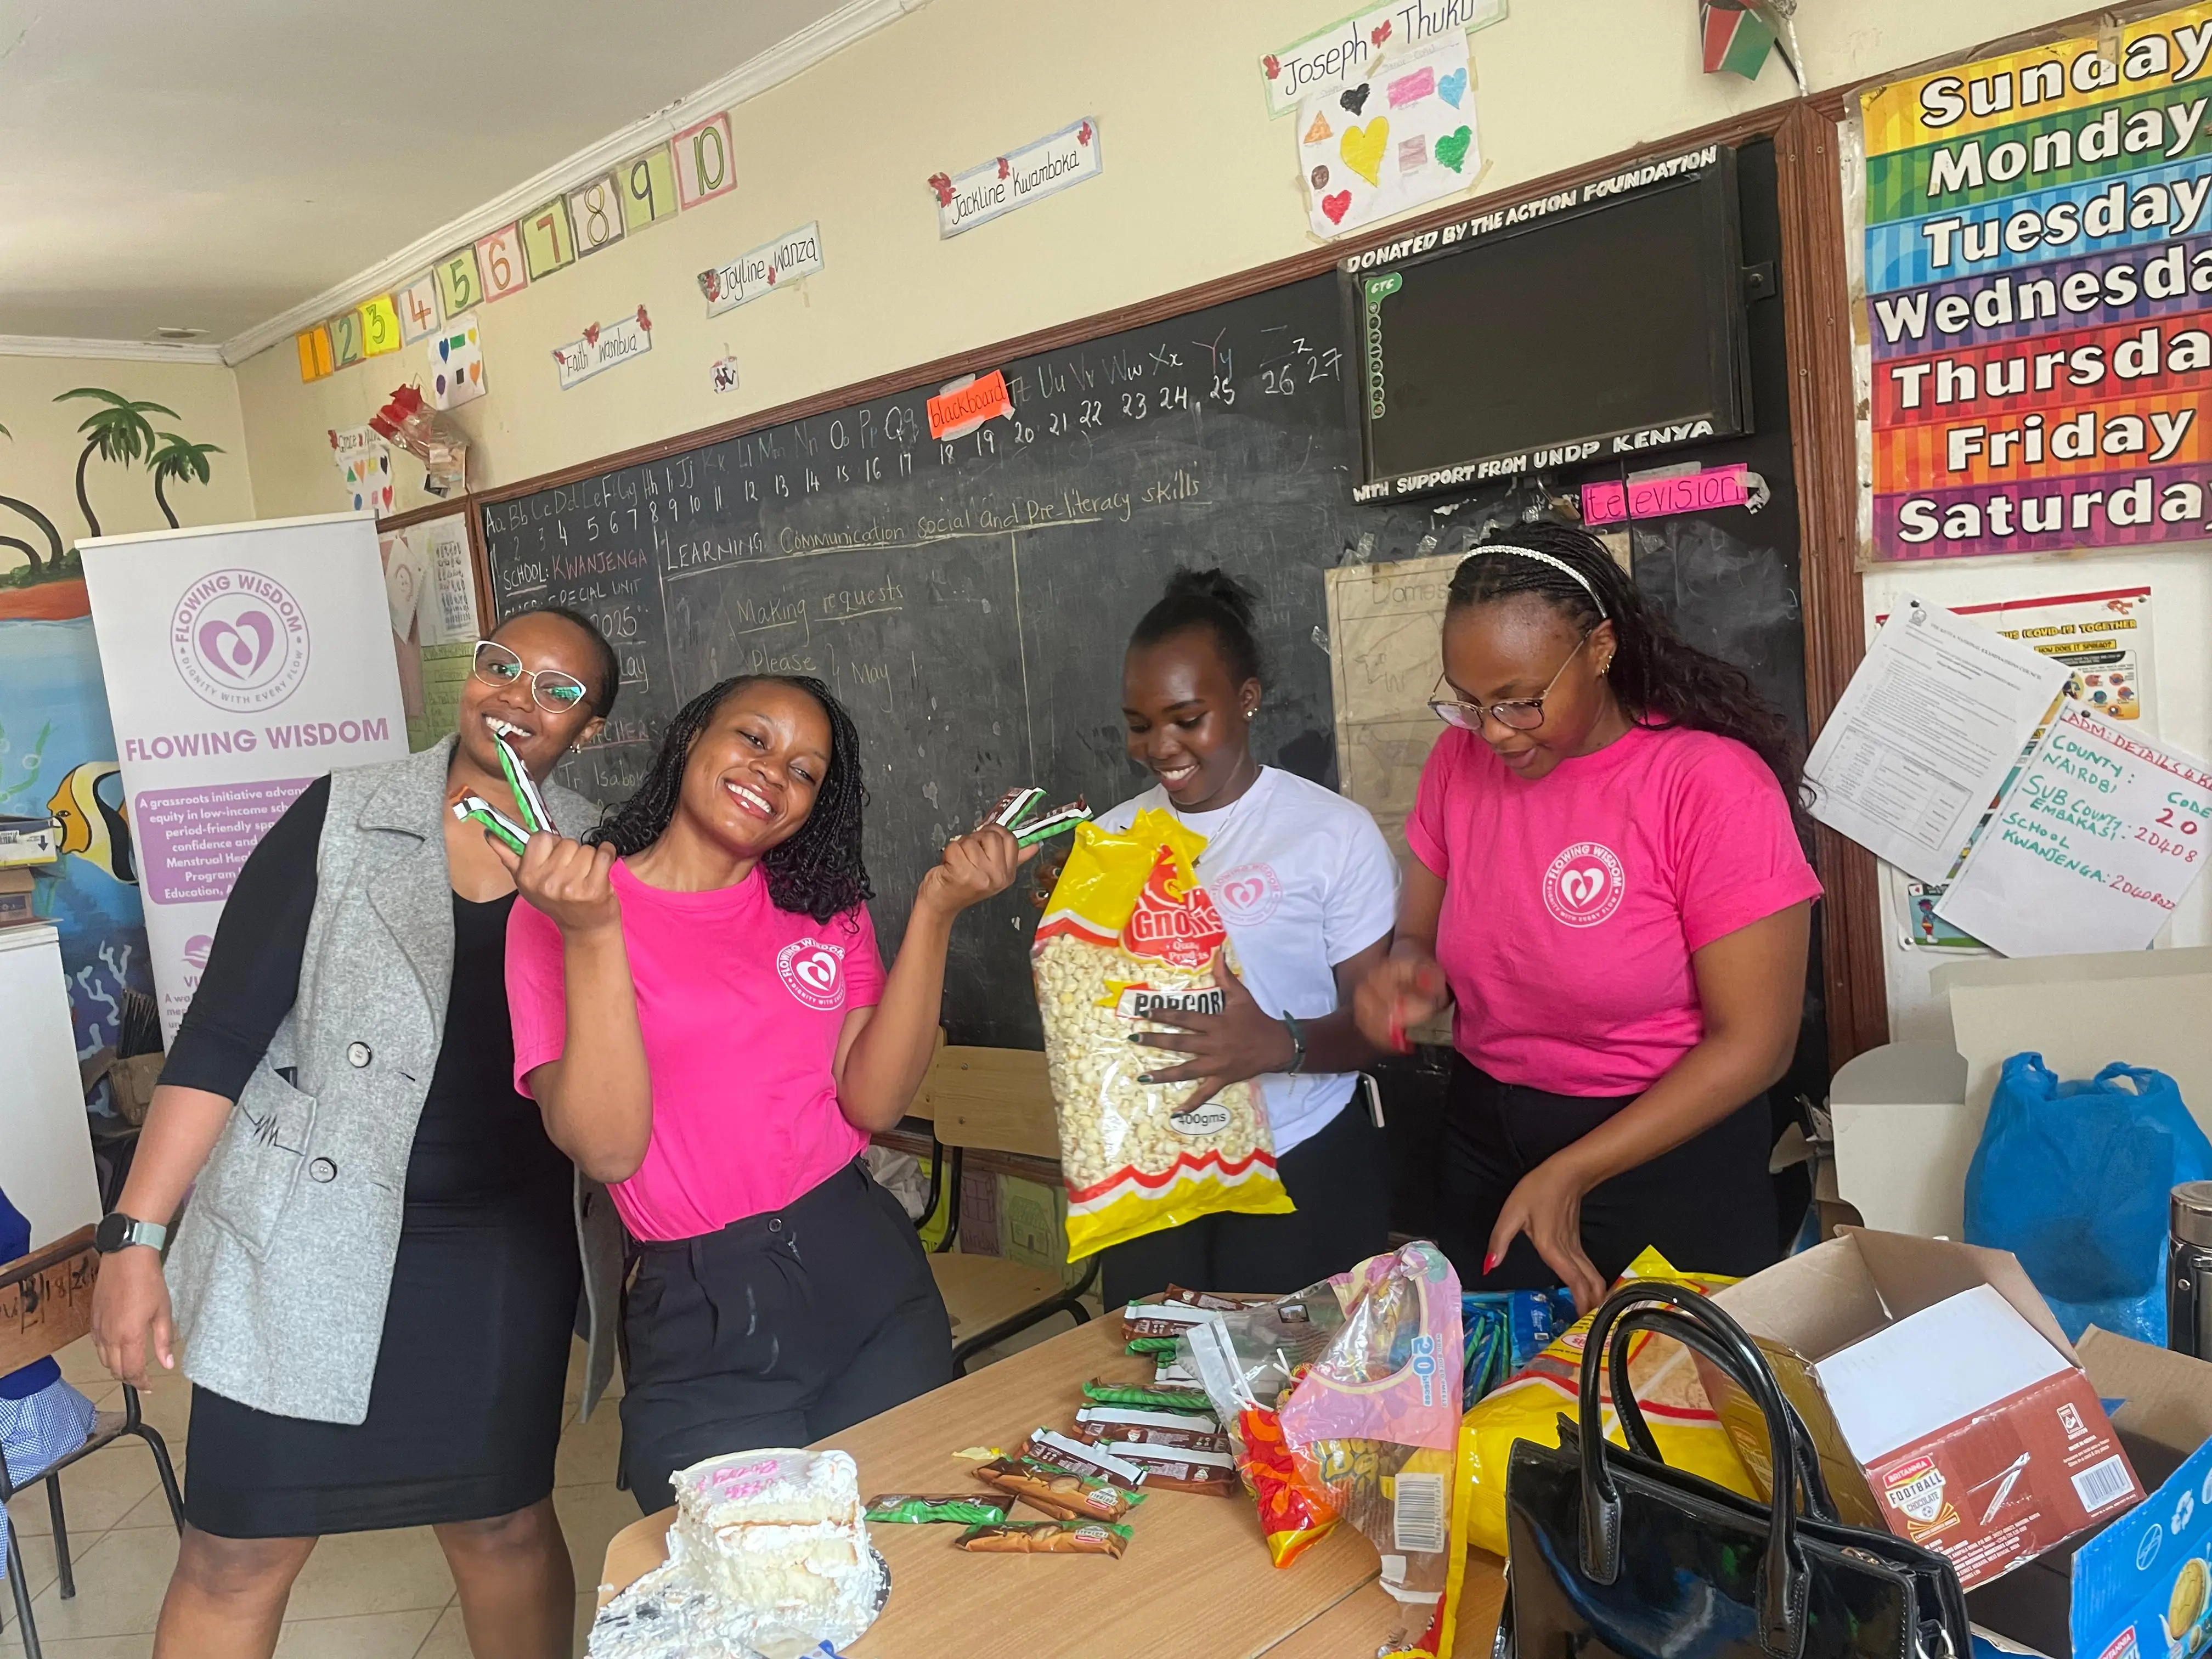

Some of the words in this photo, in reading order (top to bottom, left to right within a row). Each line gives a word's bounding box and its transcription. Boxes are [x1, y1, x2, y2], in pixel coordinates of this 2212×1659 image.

[1284, 22, 1367, 96] Joseph
[1920, 20, 2212, 128] Sunday
[1927, 97, 2209, 198] Monday
[952, 184, 1005, 225] Jackline
[1012, 151, 1080, 196] Kwamboka
[1346, 229, 1437, 274] DONATED
[1441, 223, 1468, 245] BY
[1470, 211, 1504, 238] THE
[1505, 189, 1578, 226] ACTION
[1583, 145, 1718, 202] FOUNDATION
[1922, 174, 2212, 268] Tuesday
[310, 332, 320, 377] 1
[338, 318, 358, 366] 2
[366, 304, 386, 345] 3
[410, 291, 432, 330] 4
[450, 261, 471, 309] 5
[488, 238, 511, 291] 6
[536, 214, 562, 263] 7
[584, 184, 610, 247] 8
[629, 160, 656, 221] 9
[692, 127, 725, 196] 10
[720, 258, 765, 301] Joyline
[1874, 245, 2212, 344] Wednesda
[566, 346, 589, 377] Faith
[1891, 326, 2212, 410] Thursda
[929, 371, 1007, 428] blackboard
[558, 520, 568, 546] 4
[588, 516, 600, 541] 5
[610, 511, 619, 534] 6
[627, 508, 637, 531] 7
[649, 500, 659, 522] 8
[668, 498, 678, 522] 9
[690, 495, 701, 515] 10
[744, 480, 759, 502] 12
[775, 474, 789, 498] 13
[805, 467, 821, 493] 14
[837, 465, 850, 483] 15
[866, 456, 882, 483] 16
[899, 452, 912, 478] 17
[940, 443, 956, 465] 18
[977, 429, 995, 457] 19
[1014, 421, 1035, 444] 20
[1049, 413, 1068, 436] 21
[1079, 400, 1103, 428] 22
[1121, 393, 1147, 420] 23
[1210, 375, 1235, 405] 25
[1261, 363, 1295, 396] 26
[1307, 347, 1344, 384] 27
[1352, 481, 1389, 503] WITH
[1396, 464, 1476, 495] SUPPORT
[1476, 455, 1527, 479] FROM
[1533, 441, 1601, 470] UNDP
[1612, 420, 1714, 454] KENYA
[1946, 408, 2196, 472] Friday
[509, 500, 528, 531] Bb
[554, 484, 579, 515] Dd
[676, 456, 693, 489] Jj
[1588, 476, 1741, 521] teevision
[1898, 476, 2212, 544] Saturda
[780, 524, 905, 554] Communication
[551, 548, 648, 581] KWANJENGA
[612, 577, 642, 596] UNIT
[175, 576, 231, 644] FLOWING
[238, 574, 303, 634] WISDOM
[738, 589, 809, 648] Making
[2078, 618, 2138, 634] TOGETHER
[182, 657, 218, 697] DIGNITY
[220, 692, 251, 704] WITH
[255, 680, 287, 704] EVERY
[287, 649, 304, 680] FLOW
[751, 642, 817, 673] Please
[851, 661, 894, 713] May
[125, 729, 258, 762] FLOWING
[264, 718, 390, 750] WISDOM
[139, 797, 149, 809] A
[150, 794, 210, 810] grassroots
[211, 789, 263, 802] initiative
[2021, 774, 2069, 807] SUB
[149, 812, 184, 825] equity
[187, 809, 198, 821] in
[200, 805, 268, 820] low-income
[165, 821, 252, 839] period-friendly
[2155, 807, 2198, 835] 20
[166, 854, 223, 869] Menstrual
[172, 840, 233, 853] confidence
[235, 836, 258, 848] and
[185, 871, 236, 884] Program
[1548, 845, 1590, 879] FLOWING
[1593, 845, 1623, 888] WISDOM
[164, 888, 224, 899] Education,
[1411, 1334, 1436, 1376] 20
[1887, 1460, 1928, 1483] BRITANNIA
[1889, 1472, 1943, 1505] FOOTBALL
[1906, 1491, 1939, 1513] CHOCOLATE
